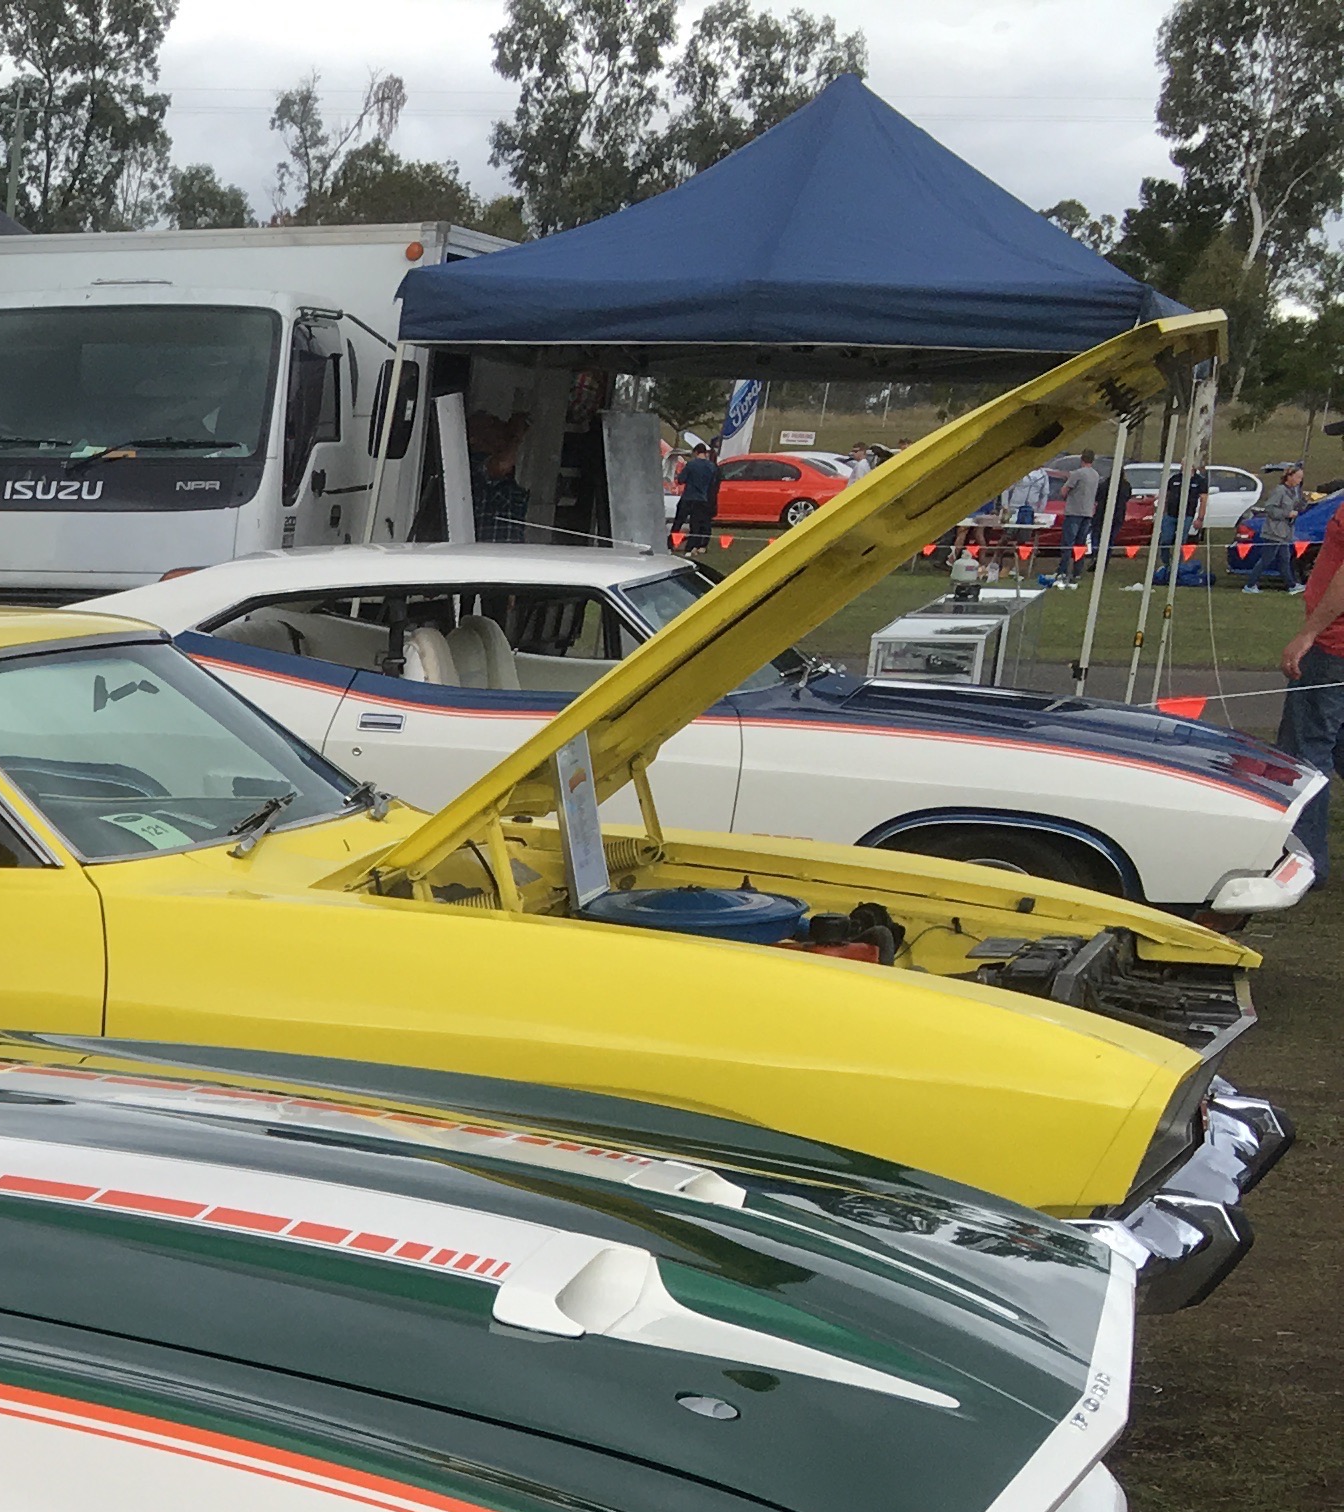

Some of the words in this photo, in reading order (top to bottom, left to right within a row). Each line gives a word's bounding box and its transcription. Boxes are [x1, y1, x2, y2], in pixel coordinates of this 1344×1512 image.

[729, 380, 762, 428] Ford
[4, 481, 103, 500] ISUZU
[175, 481, 220, 491] NPR
[1070, 1372, 1111, 1431] FORD
